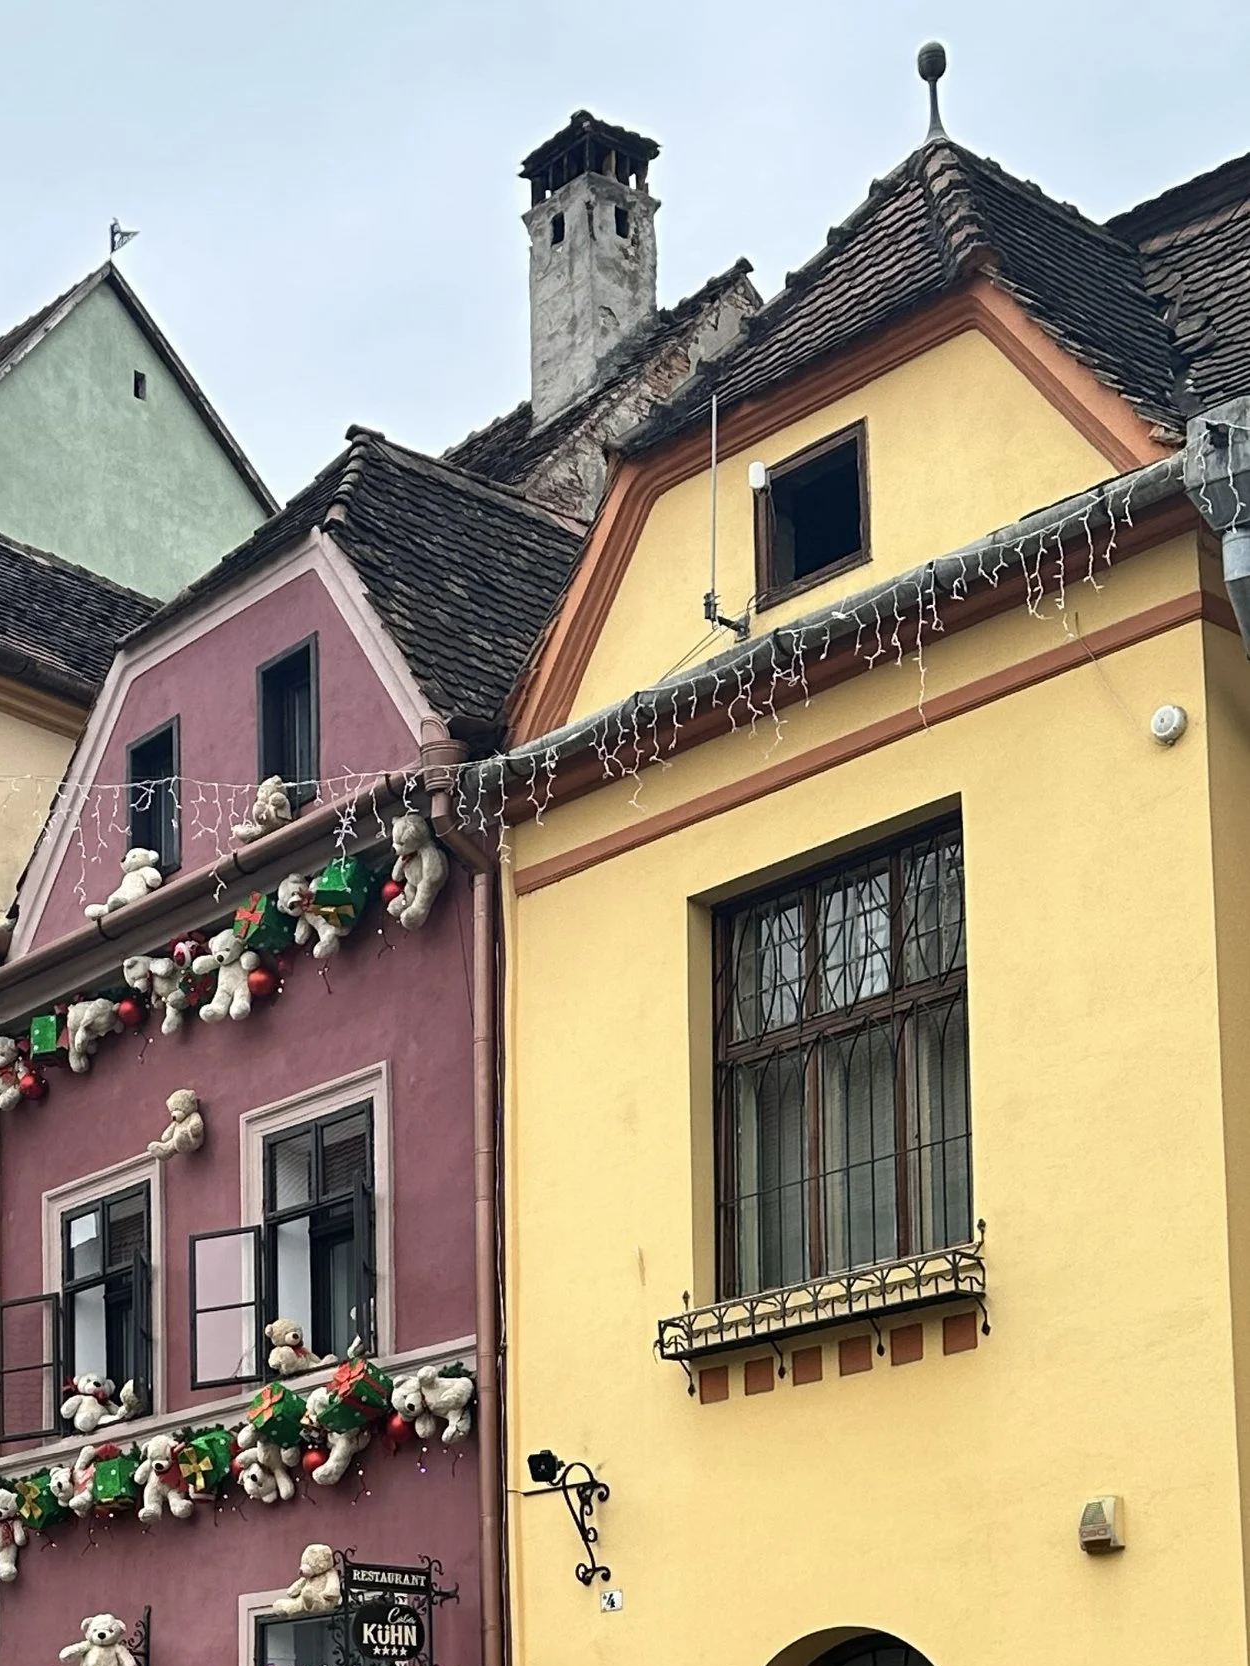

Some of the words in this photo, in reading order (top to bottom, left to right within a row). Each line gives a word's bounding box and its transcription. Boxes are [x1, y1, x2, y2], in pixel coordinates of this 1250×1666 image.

[352, 1569, 426, 1587] RESTAURANT
[606, 1593, 616, 1609] 4
[387, 1606, 417, 1625] Casa
